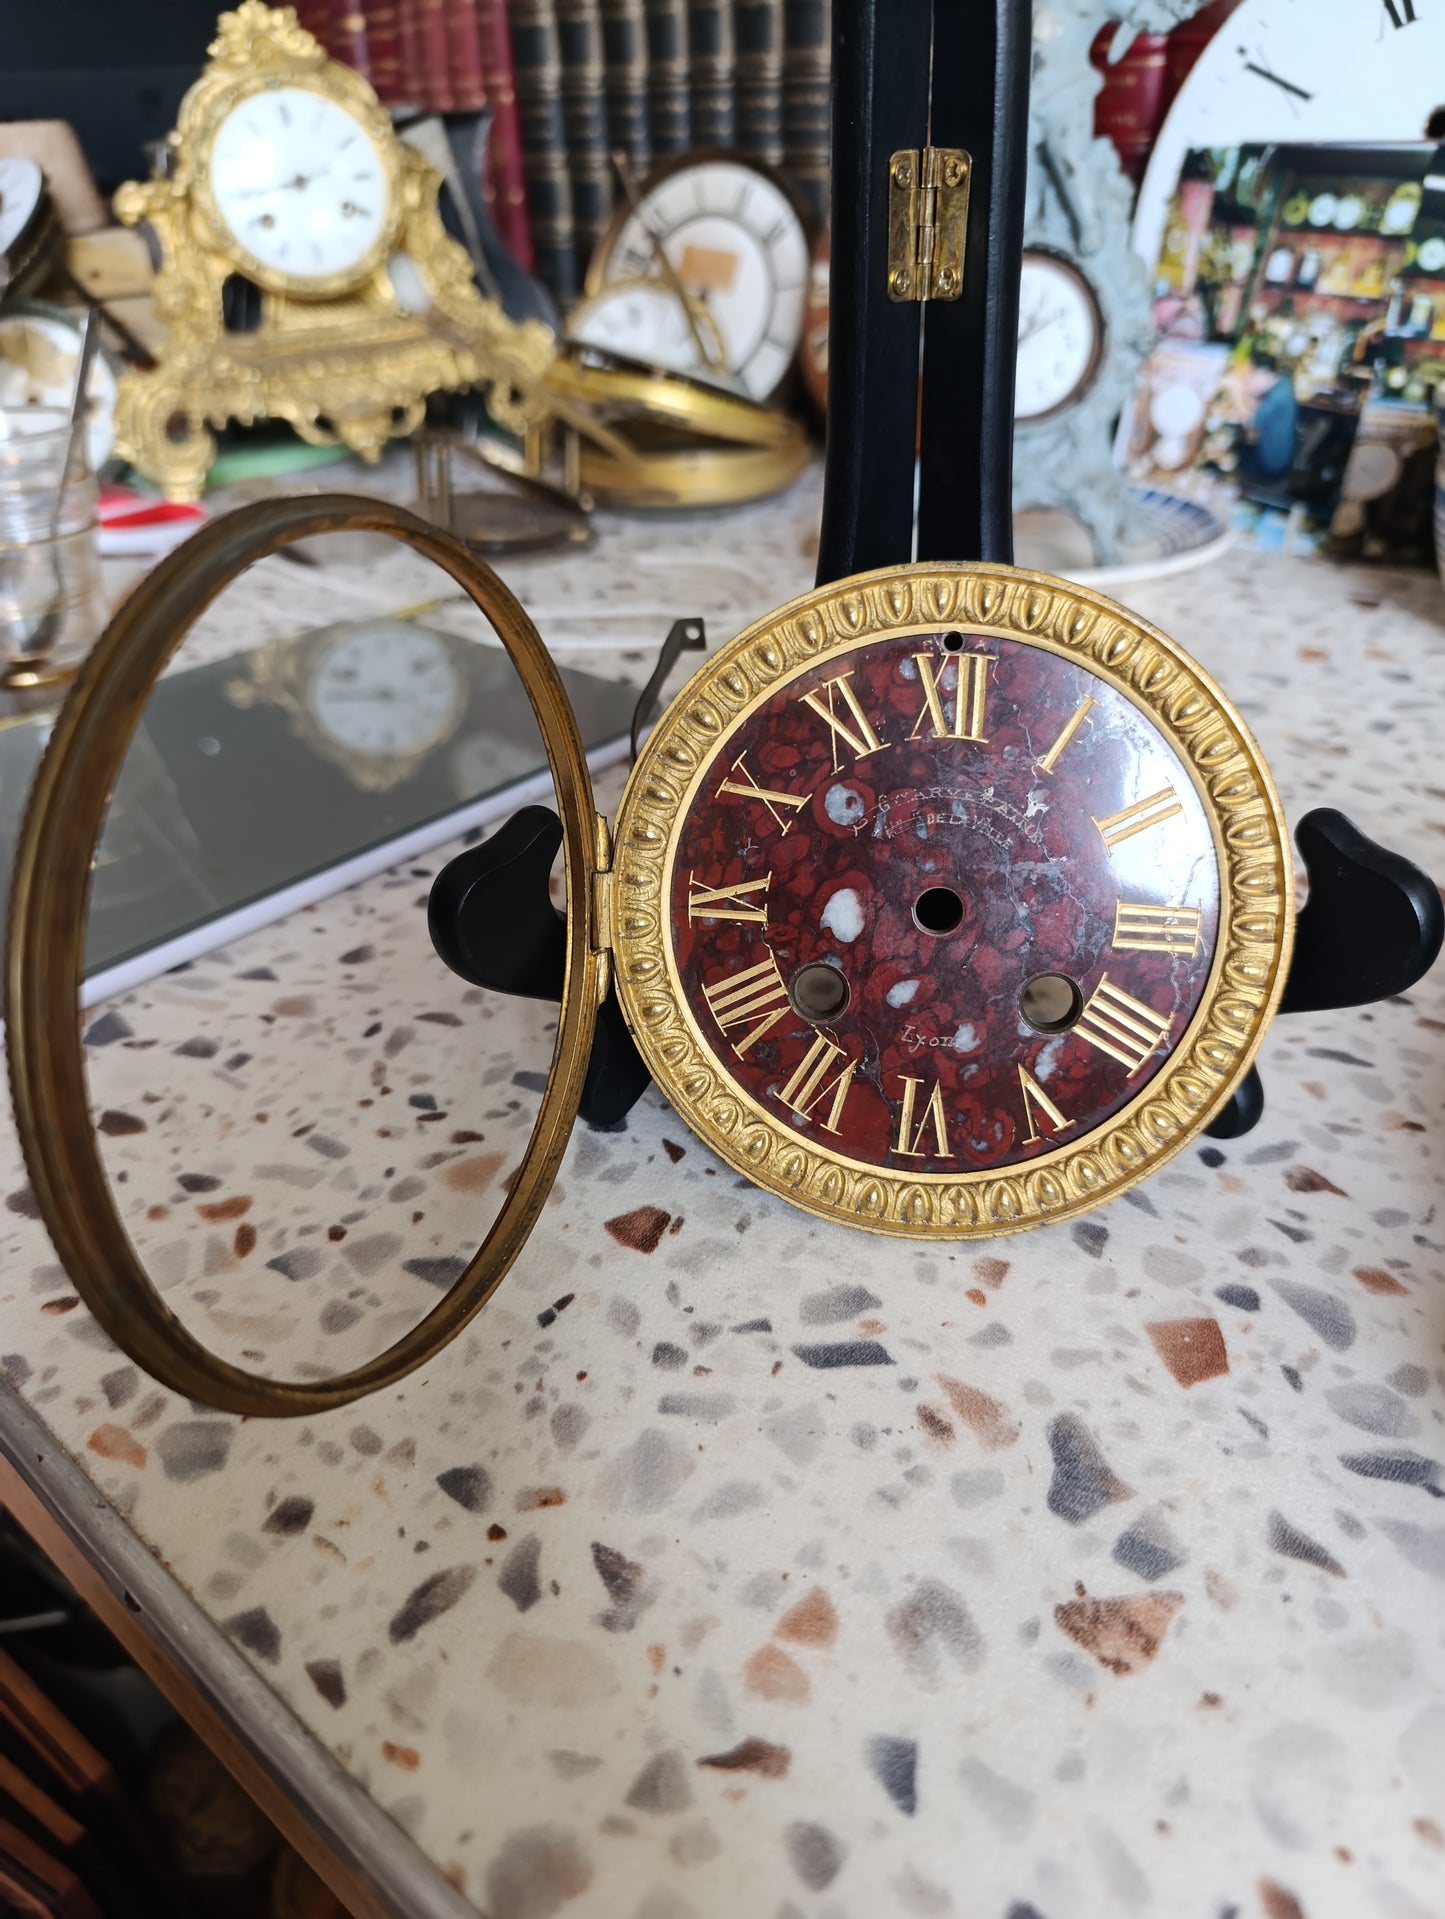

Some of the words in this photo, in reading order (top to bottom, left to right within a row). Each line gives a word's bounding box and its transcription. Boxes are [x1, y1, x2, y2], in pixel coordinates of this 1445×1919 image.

[798, 670, 892, 777] XI
[904, 652, 997, 744] XII
[714, 749, 814, 837] X
[1090, 776, 1188, 858] II
[687, 869, 773, 931] IX
[1110, 894, 1202, 960] III
[701, 946, 793, 1062] VIII
[1071, 971, 1177, 1079] IIII
[772, 1028, 858, 1136] VII
[890, 1074, 955, 1158] VI
[1016, 1062, 1077, 1145] V
